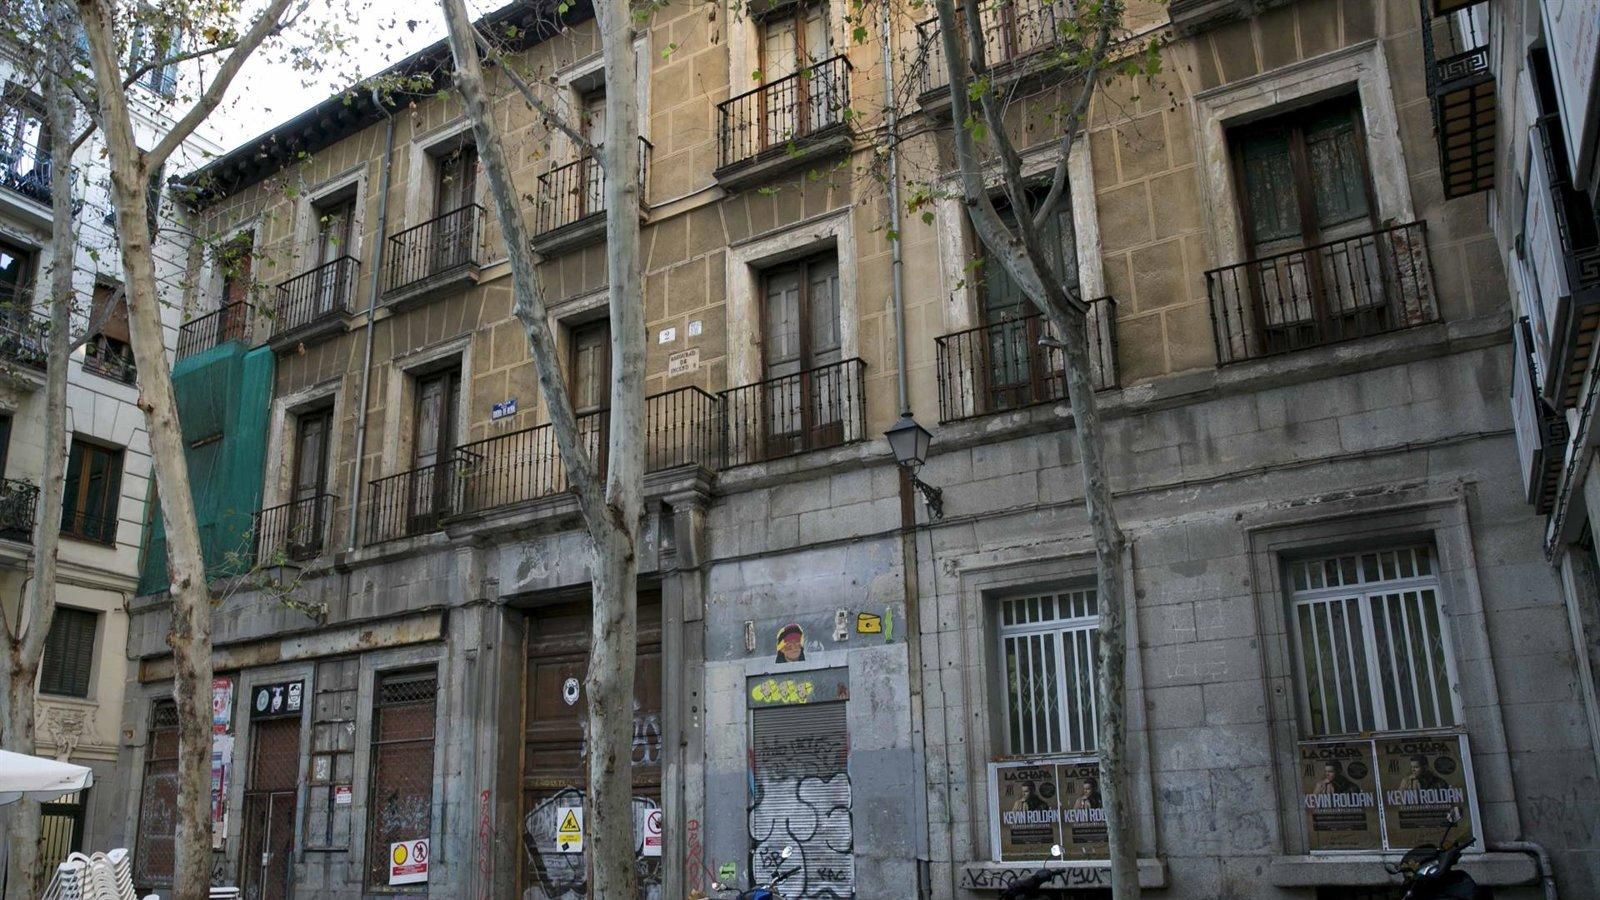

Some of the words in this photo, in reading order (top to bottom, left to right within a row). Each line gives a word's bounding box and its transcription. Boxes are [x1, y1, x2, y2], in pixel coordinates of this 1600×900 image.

[1303, 750, 1318, 759] LA
[1386, 745, 1403, 754] LA
[1005, 772, 1016, 781] LA
[1065, 769, 1077, 778] LA
[1080, 768, 1099, 778] CHA
[1305, 793, 1331, 808] KEVIN
[1333, 789, 1374, 808] ROLDÁN
[1387, 789, 1418, 806] KEVIN
[1420, 785, 1464, 804] ROLDÁN
[1004, 810, 1026, 824] KEVIN
[1028, 807, 1060, 823] ROLDÁN
[1064, 809, 1088, 823] KEVIN
